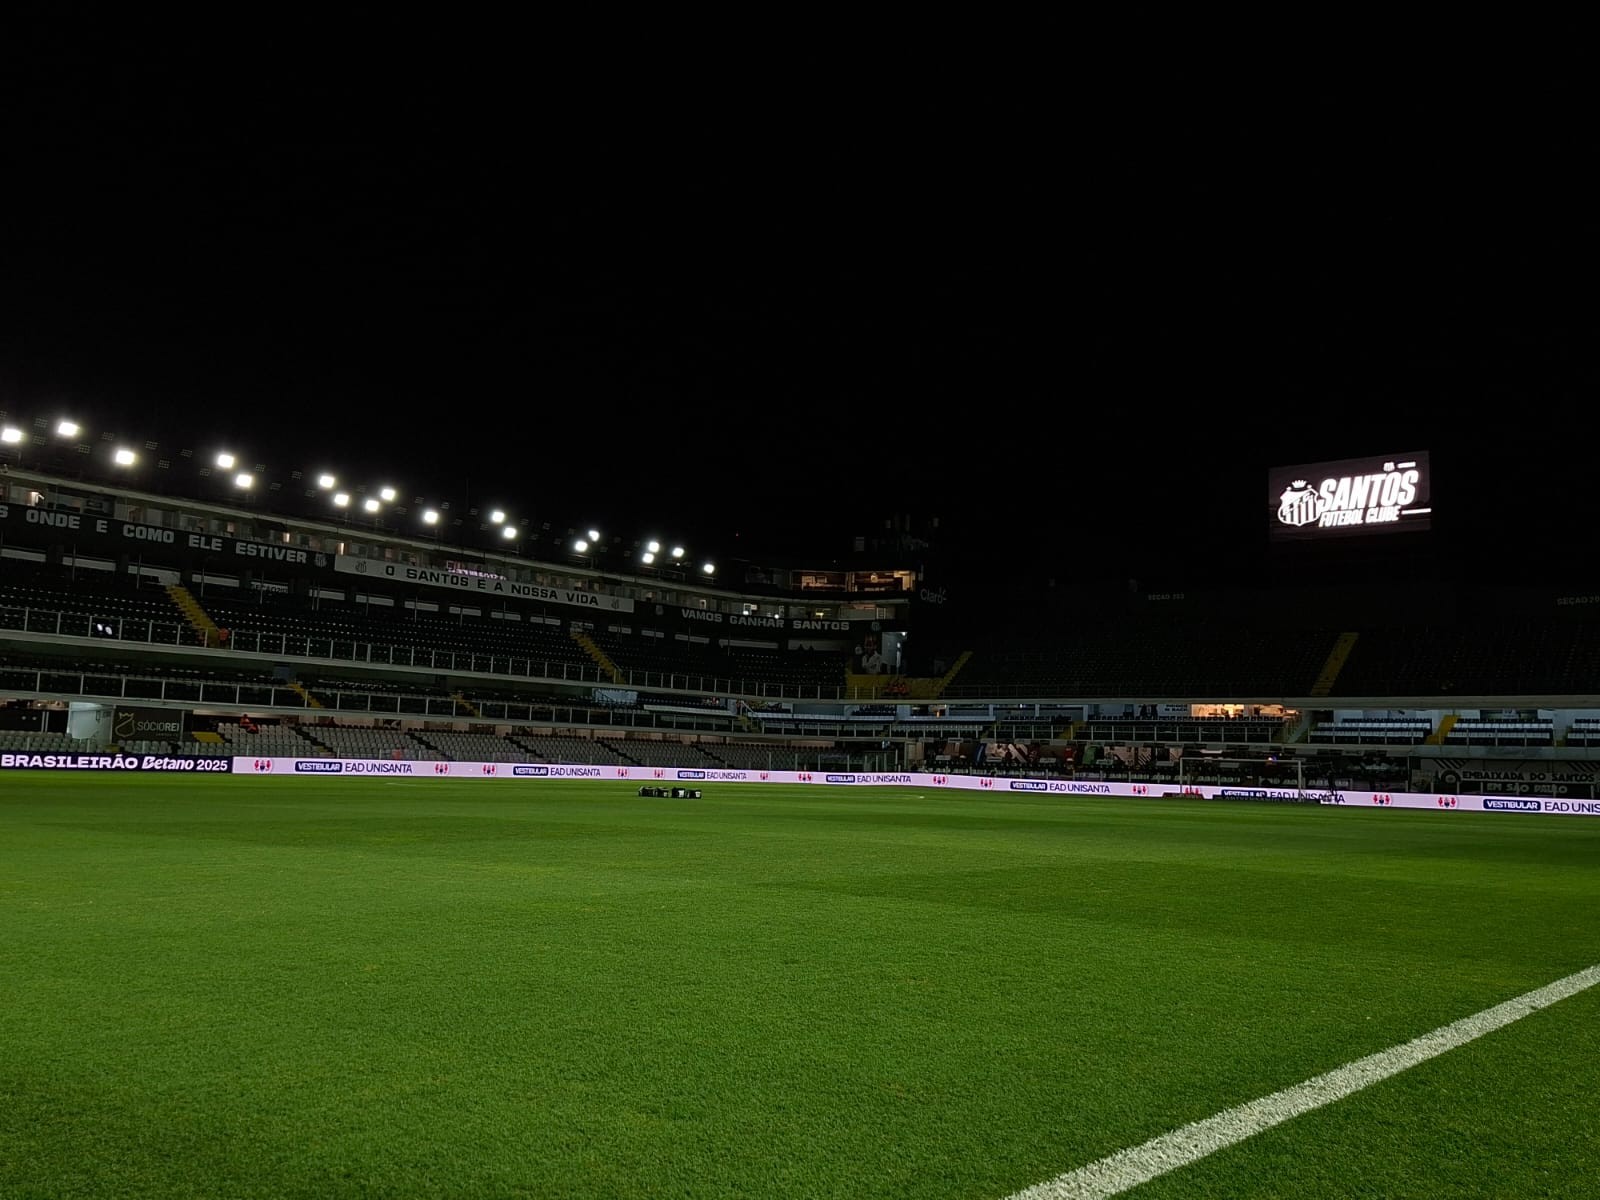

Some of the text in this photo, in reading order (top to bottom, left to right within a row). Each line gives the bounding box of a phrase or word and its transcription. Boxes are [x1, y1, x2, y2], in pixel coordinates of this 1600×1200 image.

[1317, 470, 1419, 513] SANTOS
[1319, 505, 1401, 527] FUTEBOL CLUBE
[26, 509, 80, 529] ONDE
[96, 519, 108, 533] E
[123, 524, 174, 543] COMO
[188, 534, 223, 551] ELE
[235, 541, 307, 564] ESTIVER
[385, 565, 395, 576] O
[406, 568, 468, 586] SANTOS
[494, 582, 503, 592] A
[511, 584, 557, 599] NOSSA
[566, 592, 598, 606] VIDA
[681, 608, 850, 631] VAMOS GANHAR SANTOS
[0, 754, 228, 771] BRASILEIRÃO Betano 2025
[297, 762, 412, 774] VESTIBULAR EAD UNISANTA
[550, 767, 565, 776] EAD
[566, 767, 601, 777] UNISANTA
[1462, 770, 1594, 782] EMBAIXADA DO SANTOS
[857, 775, 871, 783] EAD
[873, 775, 911, 784] UNISANTA
[1049, 782, 1066, 792] EAD
[1068, 783, 1111, 794] UNISANTA
[1486, 782, 1502, 792] EM
[1487, 800, 1600, 814] VESTIBULAR EAD UNIS
